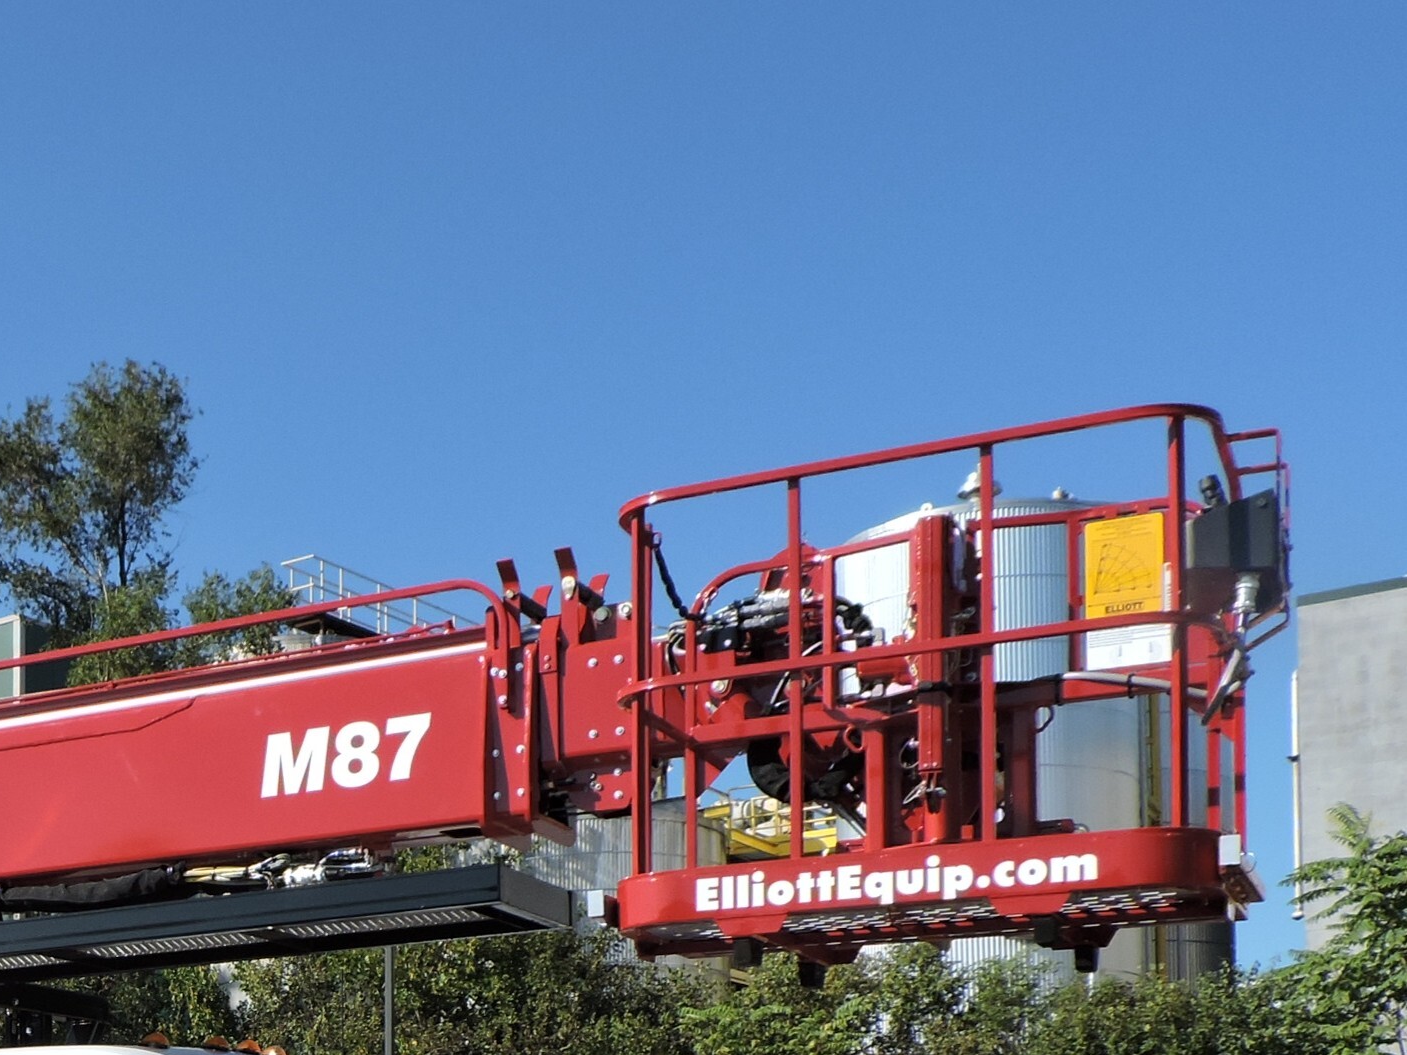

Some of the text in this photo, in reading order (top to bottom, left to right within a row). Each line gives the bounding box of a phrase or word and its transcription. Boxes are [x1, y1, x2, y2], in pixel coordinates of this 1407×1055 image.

[1105, 602, 1143, 614] ELLIOTT
[260, 712, 432, 799] M87
[695, 852, 1099, 911] ElliottEquip.com
